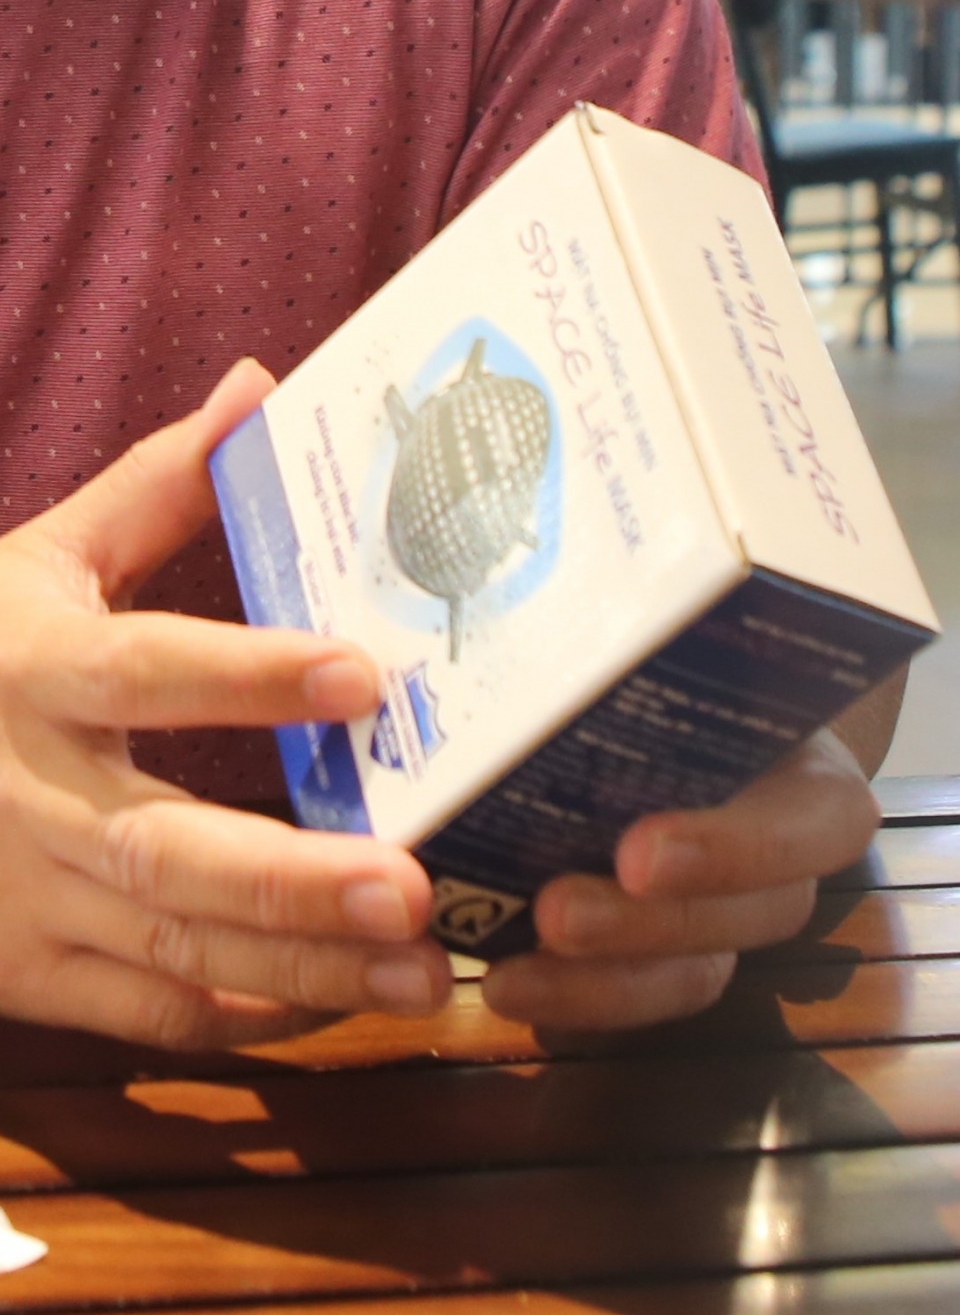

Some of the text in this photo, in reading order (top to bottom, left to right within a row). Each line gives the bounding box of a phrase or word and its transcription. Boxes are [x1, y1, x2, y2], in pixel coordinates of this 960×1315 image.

[518, 219, 646, 559] SPACE Life MASK
[716, 216, 861, 546] SPACE Life MASK
